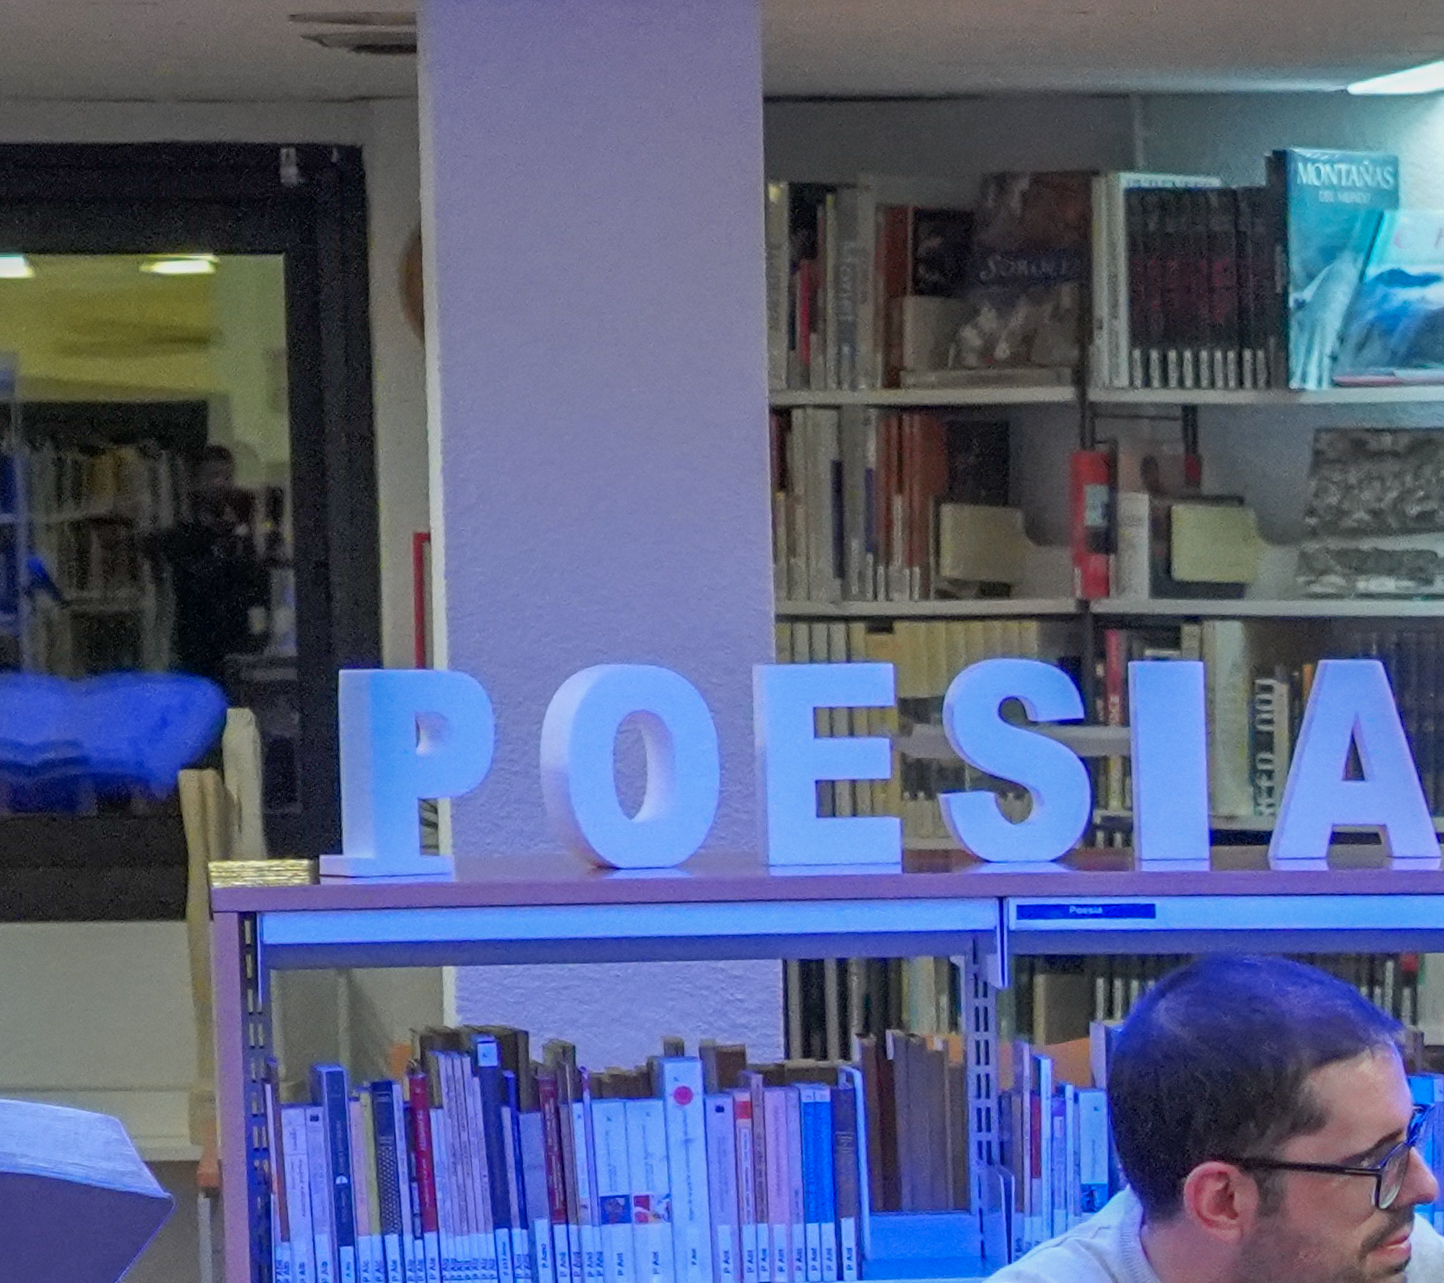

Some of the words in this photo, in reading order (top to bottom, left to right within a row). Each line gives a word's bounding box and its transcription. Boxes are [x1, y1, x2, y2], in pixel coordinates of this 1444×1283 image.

[1297, 160, 1394, 191] MONTAÑAS
[319, 658, 1443, 878] POESIA
[1069, 905, 1103, 914] Poesia
